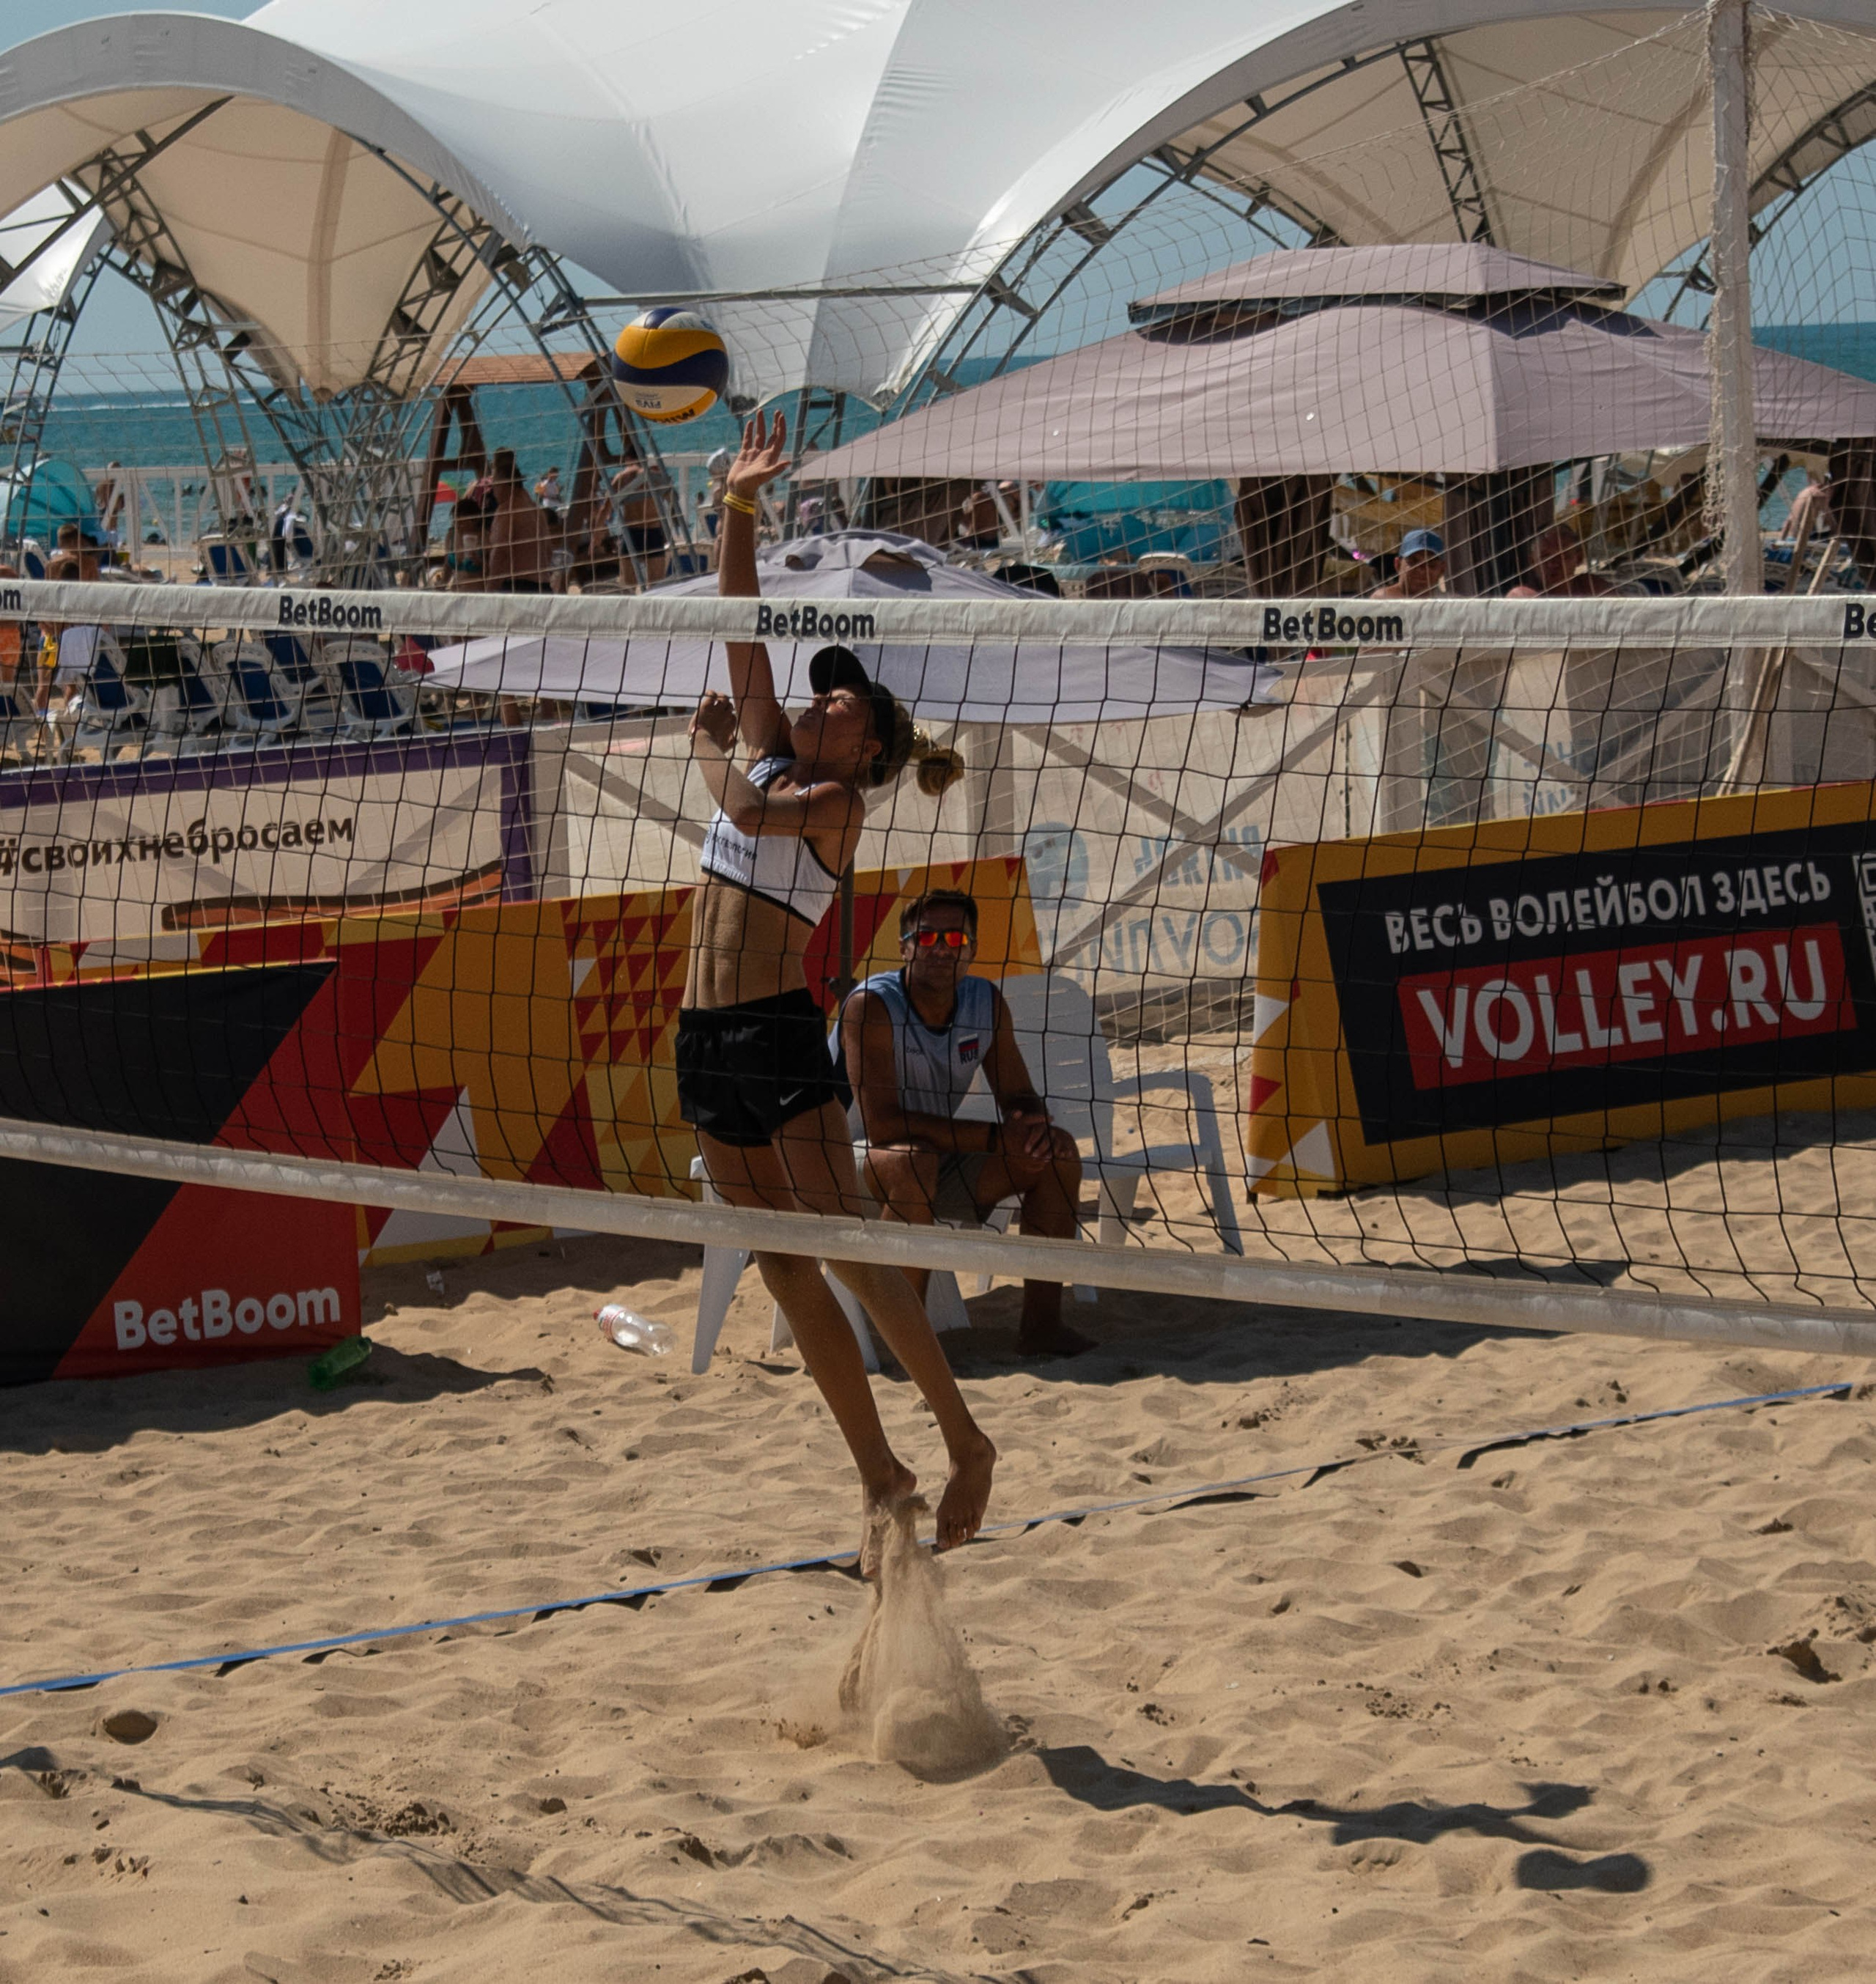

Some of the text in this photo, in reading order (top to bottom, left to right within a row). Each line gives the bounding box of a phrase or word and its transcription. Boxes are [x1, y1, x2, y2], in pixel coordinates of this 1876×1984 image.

[0, 589, 21, 610] m
[278, 595, 383, 629] BetBoom
[756, 605, 875, 638] BetBoom
[1263, 607, 1403, 641] BetBoom
[1386, 861, 1831, 954] ВЕСЬ ВОЛЕЙБОЛ ЗДЕСЬ
[1416, 940, 1828, 1069] VOLLEY.RU
[114, 1287, 341, 1351] BetBoom
